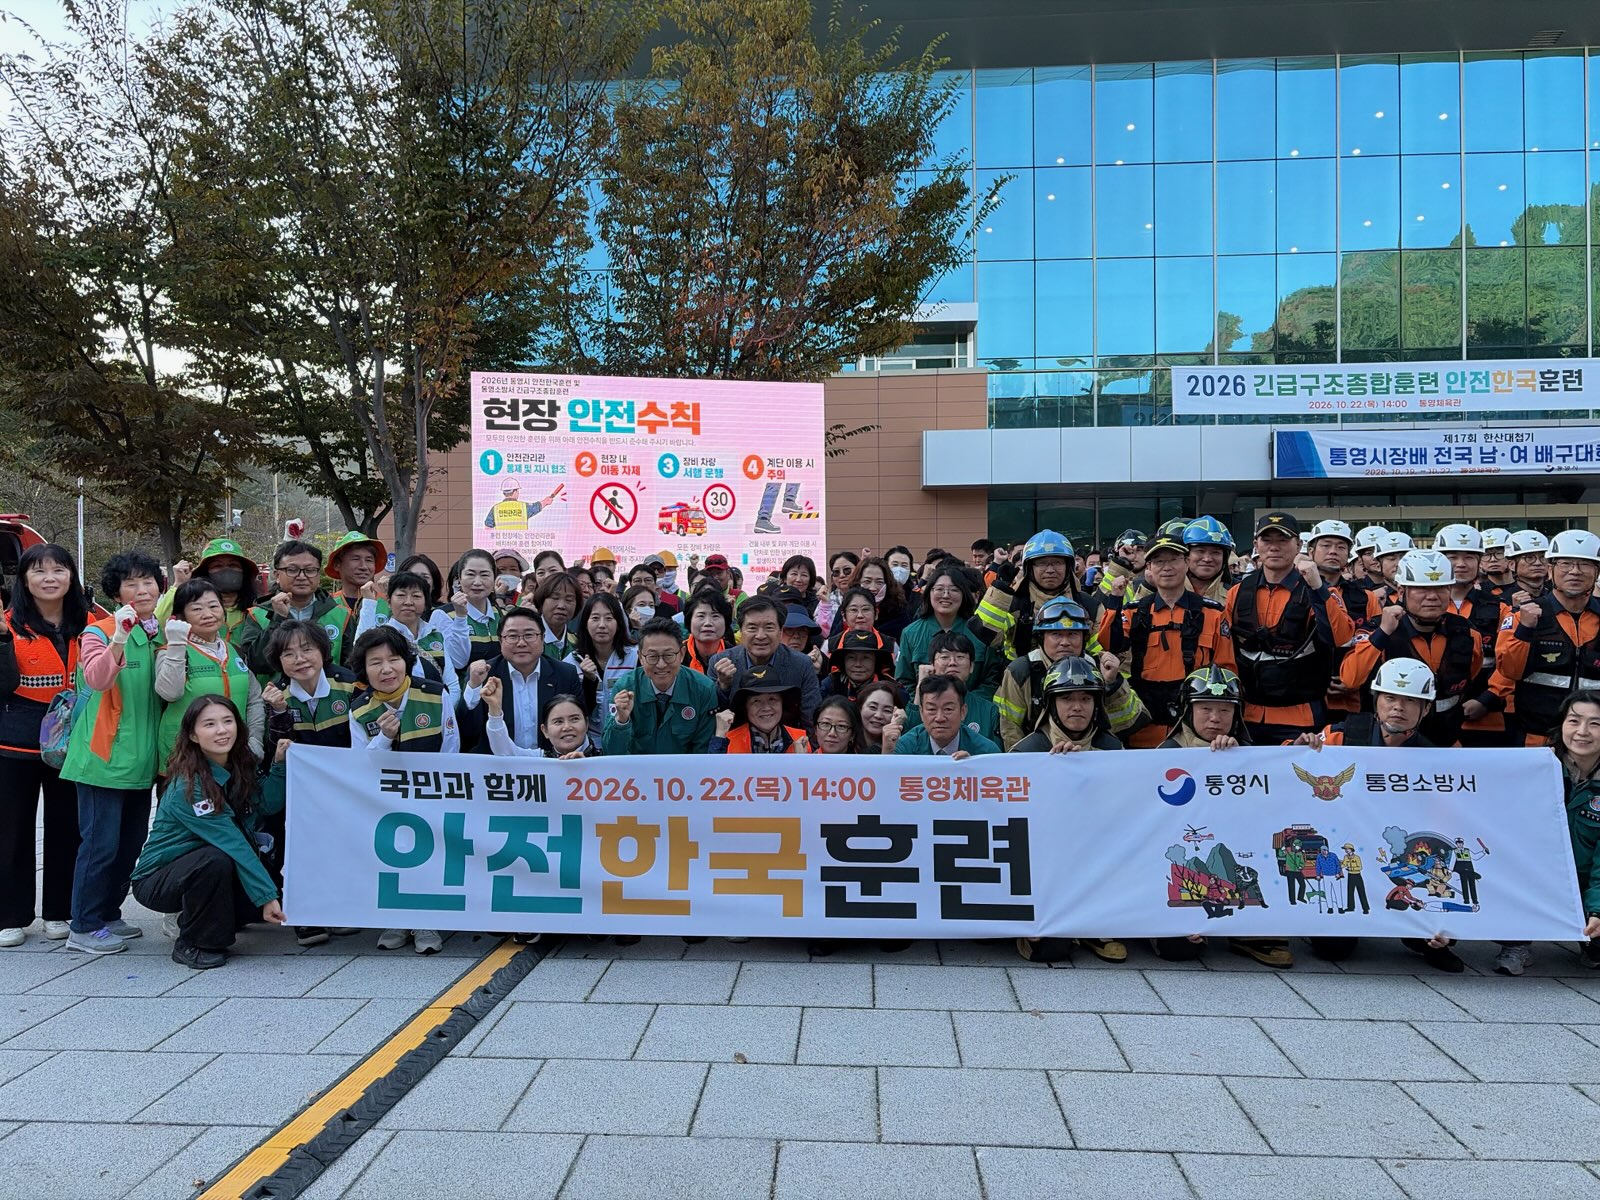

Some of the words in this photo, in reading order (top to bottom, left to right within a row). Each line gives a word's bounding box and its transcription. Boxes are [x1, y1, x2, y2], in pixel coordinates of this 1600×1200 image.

[481, 376, 508, 385] 2026년
[532, 378, 572, 387] 안전한국훈련
[1186, 374, 1246, 397] 2026
[1253, 371, 1439, 397] 긴급구조종합훈련
[1445, 368, 1583, 394] 안전한국훈련
[1309, 401, 1334, 409] 2026.
[1350, 400, 1379, 409] 22.(목)
[1382, 399, 1407, 408] 14:00
[1419, 399, 1461, 408] 통영체육관
[483, 398, 561, 432] 현장
[567, 398, 701, 436] 안전수칙
[1443, 433, 1477, 444] 제17회
[1483, 432, 1535, 443] 한산대첩기
[506, 453, 545, 462] 안전관리관
[601, 455, 617, 464] 현장
[619, 455, 628, 464] 내
[1329, 447, 1428, 466] 통영시장배
[1433, 446, 1473, 466] 전국
[1535, 444, 1600, 463] 배구대
[683, 457, 699, 467] 장비
[700, 457, 716, 467] 차량
[767, 458, 783, 469] 계단
[786, 458, 803, 469] 이용
[806, 458, 814, 469] 시
[524, 464, 532, 473] 및
[534, 464, 549, 473] 지시
[600, 465, 619, 475] 이동
[622, 465, 641, 476] 자제
[683, 468, 702, 478] 서행
[705, 468, 724, 479] 운행
[767, 469, 785, 480] 주의
[710, 491, 728, 507] 30
[379, 768, 475, 800] 국민과
[483, 772, 547, 803] 함께
[566, 777, 647, 802] 2026.
[654, 777, 693, 802] 10.
[700, 776, 792, 802] 22.(목)
[798, 776, 876, 801] 14:00
[899, 776, 1031, 802] 통영체육관
[1204, 773, 1270, 796] 통영시
[1365, 772, 1477, 794] 통영소방서
[374, 811, 1035, 921] 안전한국훈련
